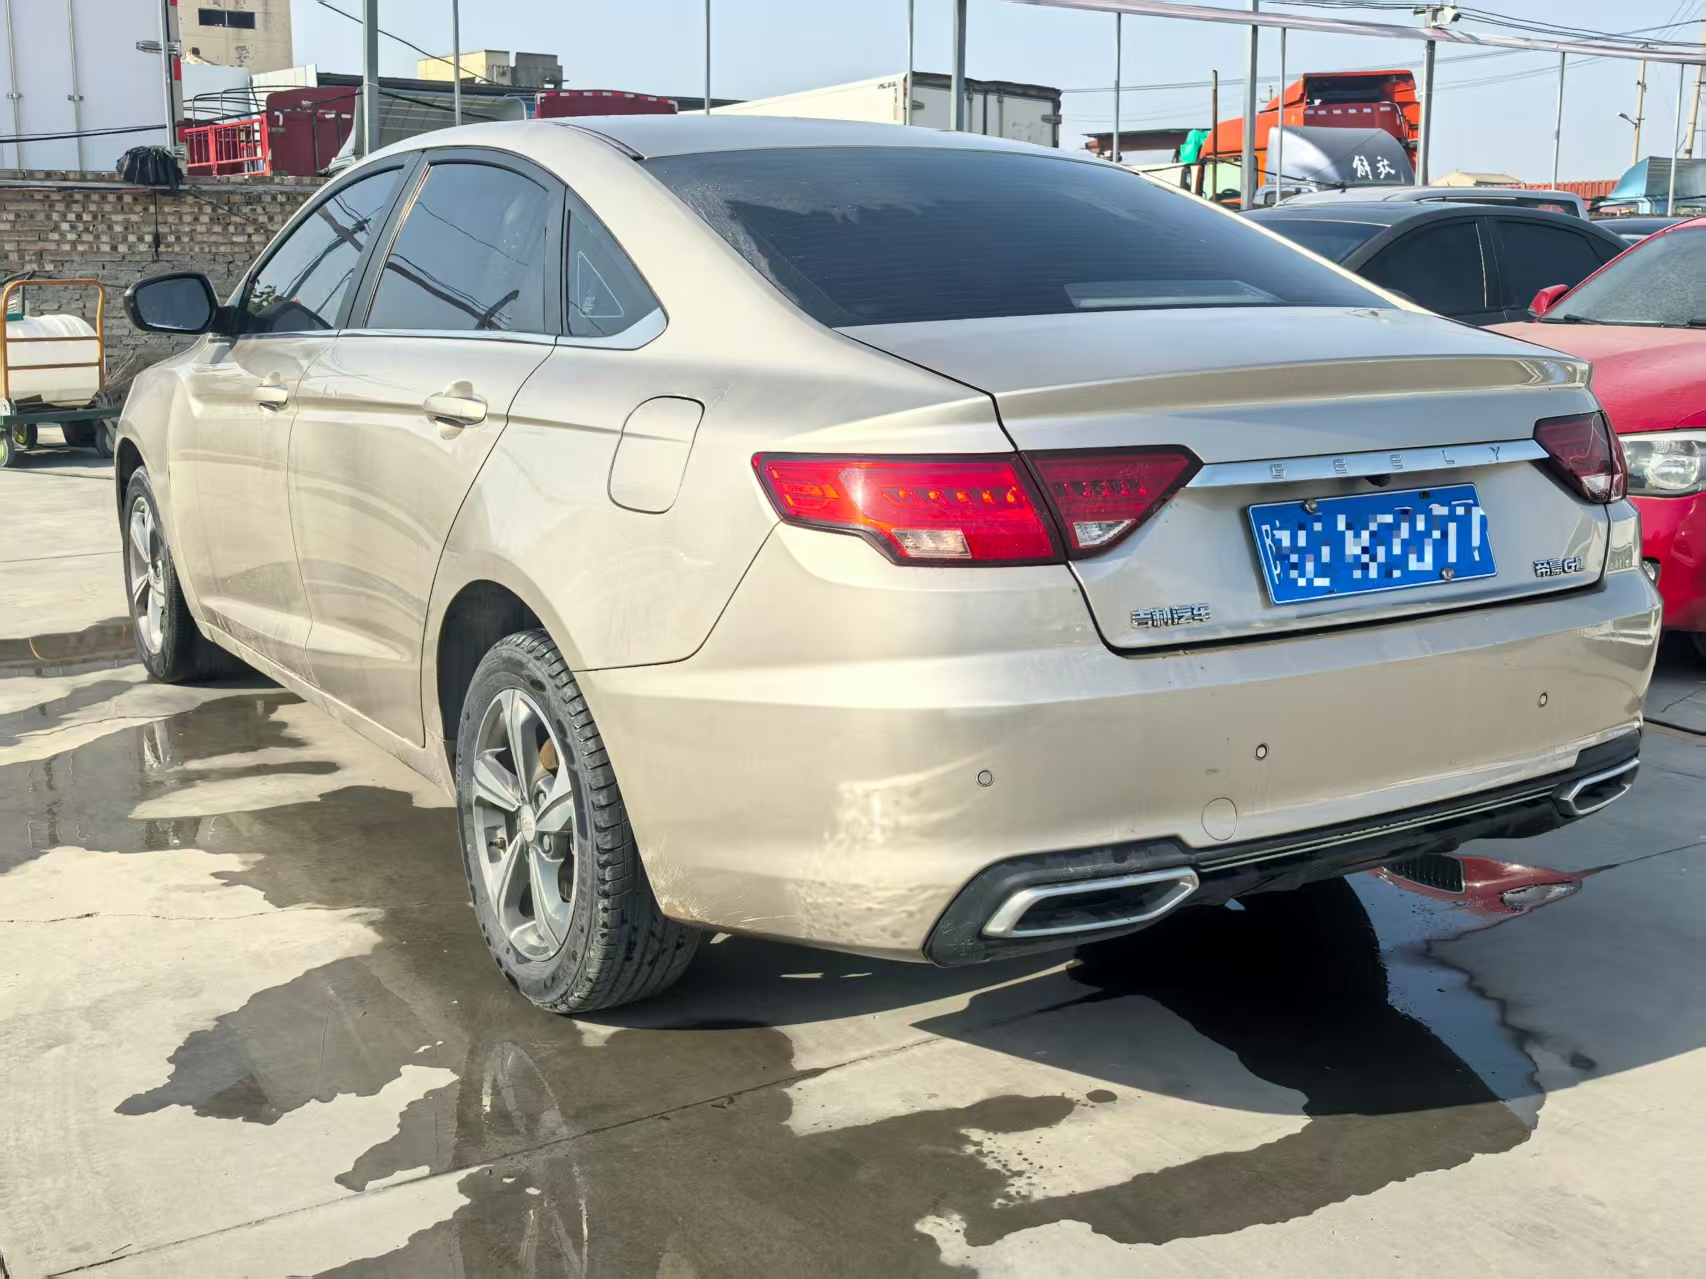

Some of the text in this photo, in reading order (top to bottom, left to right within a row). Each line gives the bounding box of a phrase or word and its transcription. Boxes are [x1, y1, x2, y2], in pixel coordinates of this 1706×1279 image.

[1270, 446, 1500, 480] GEELY
[1131, 602, 1211, 628] 吉利汽车
